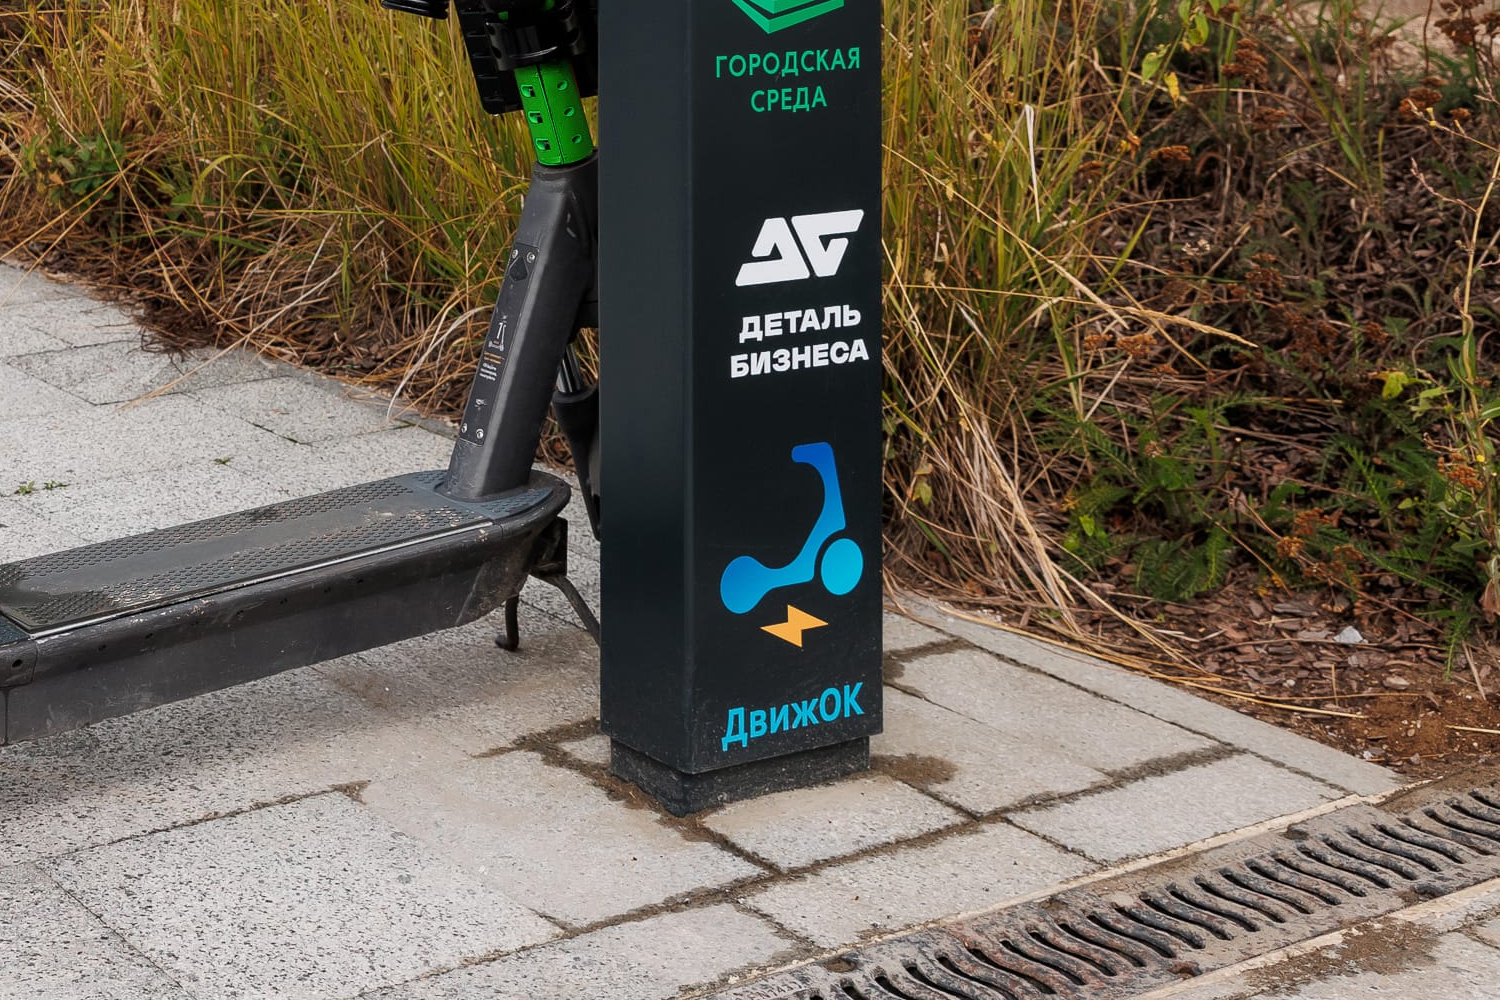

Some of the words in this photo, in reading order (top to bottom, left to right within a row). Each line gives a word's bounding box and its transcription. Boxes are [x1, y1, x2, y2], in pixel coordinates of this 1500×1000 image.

[715, 47, 860, 79] ГОРОДСКАЯ
[750, 86, 828, 113] СРЕДА
[739, 304, 862, 344] ДЕТАЛЬ
[730, 338, 870, 379] БИЗНЕСА
